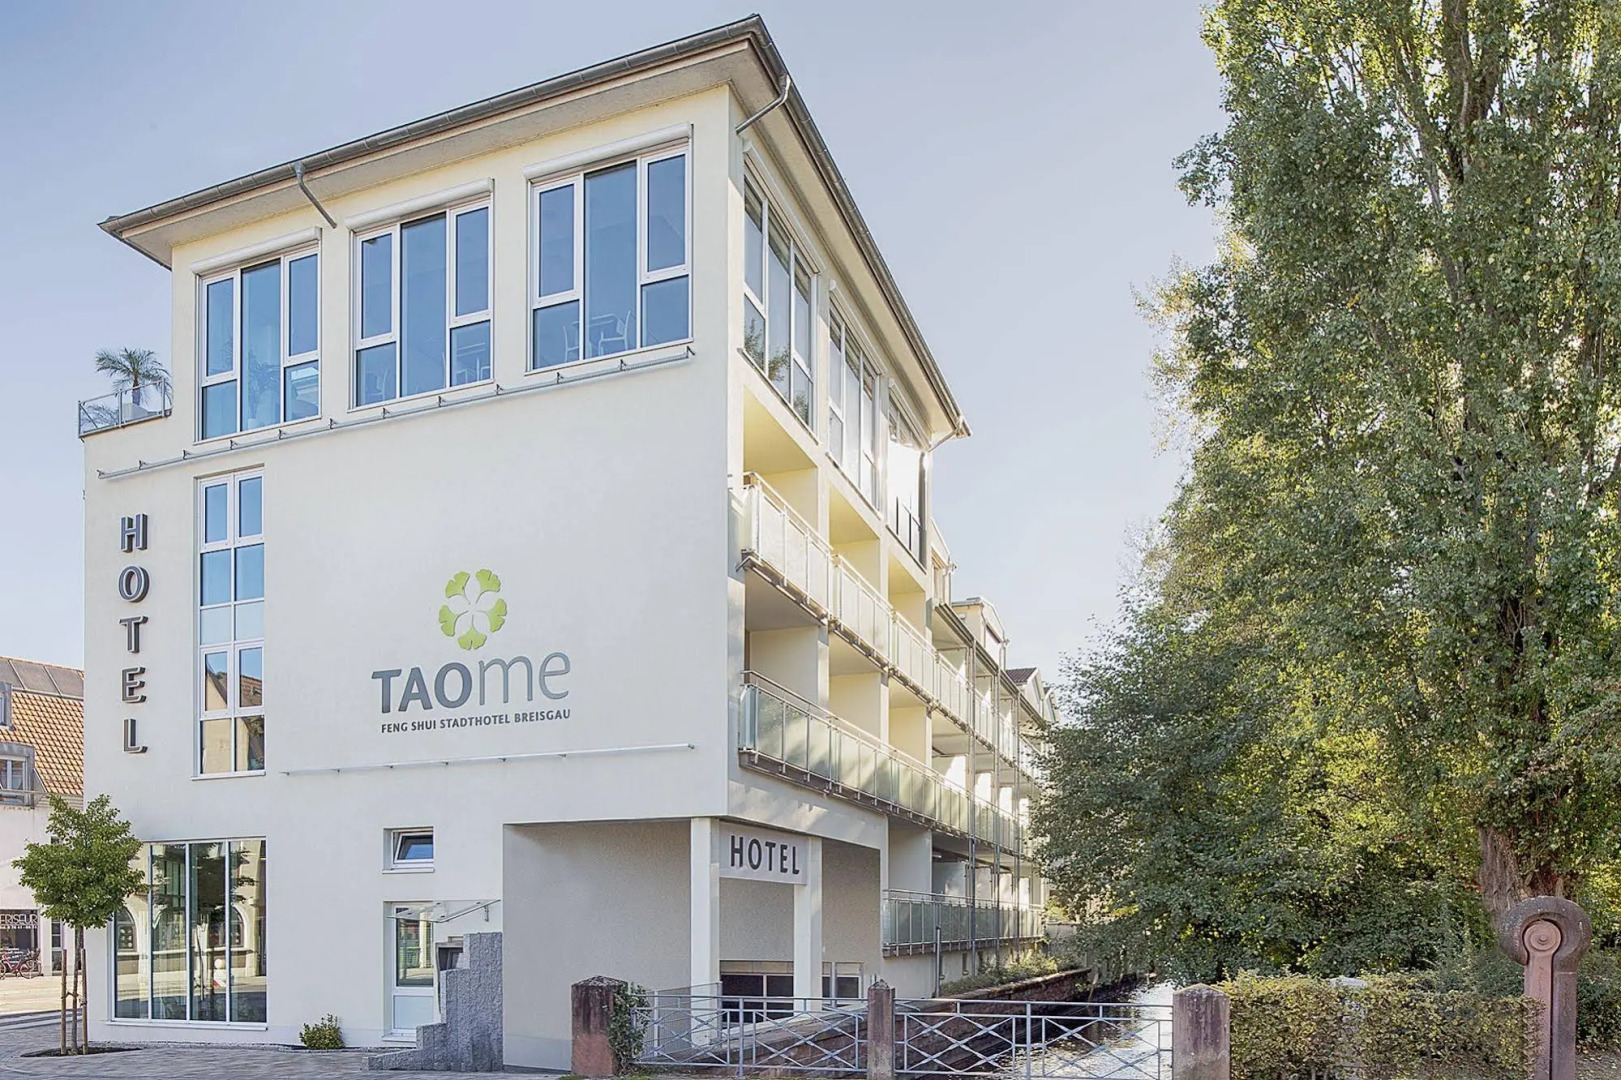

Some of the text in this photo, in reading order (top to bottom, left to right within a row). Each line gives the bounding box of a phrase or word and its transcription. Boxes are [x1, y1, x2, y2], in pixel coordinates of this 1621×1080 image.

[118, 513, 150, 754] HOTEL
[381, 709, 571, 733] FENG SHUI STADTHOTEL BREISGAU
[730, 835, 800, 875] HOTEL
